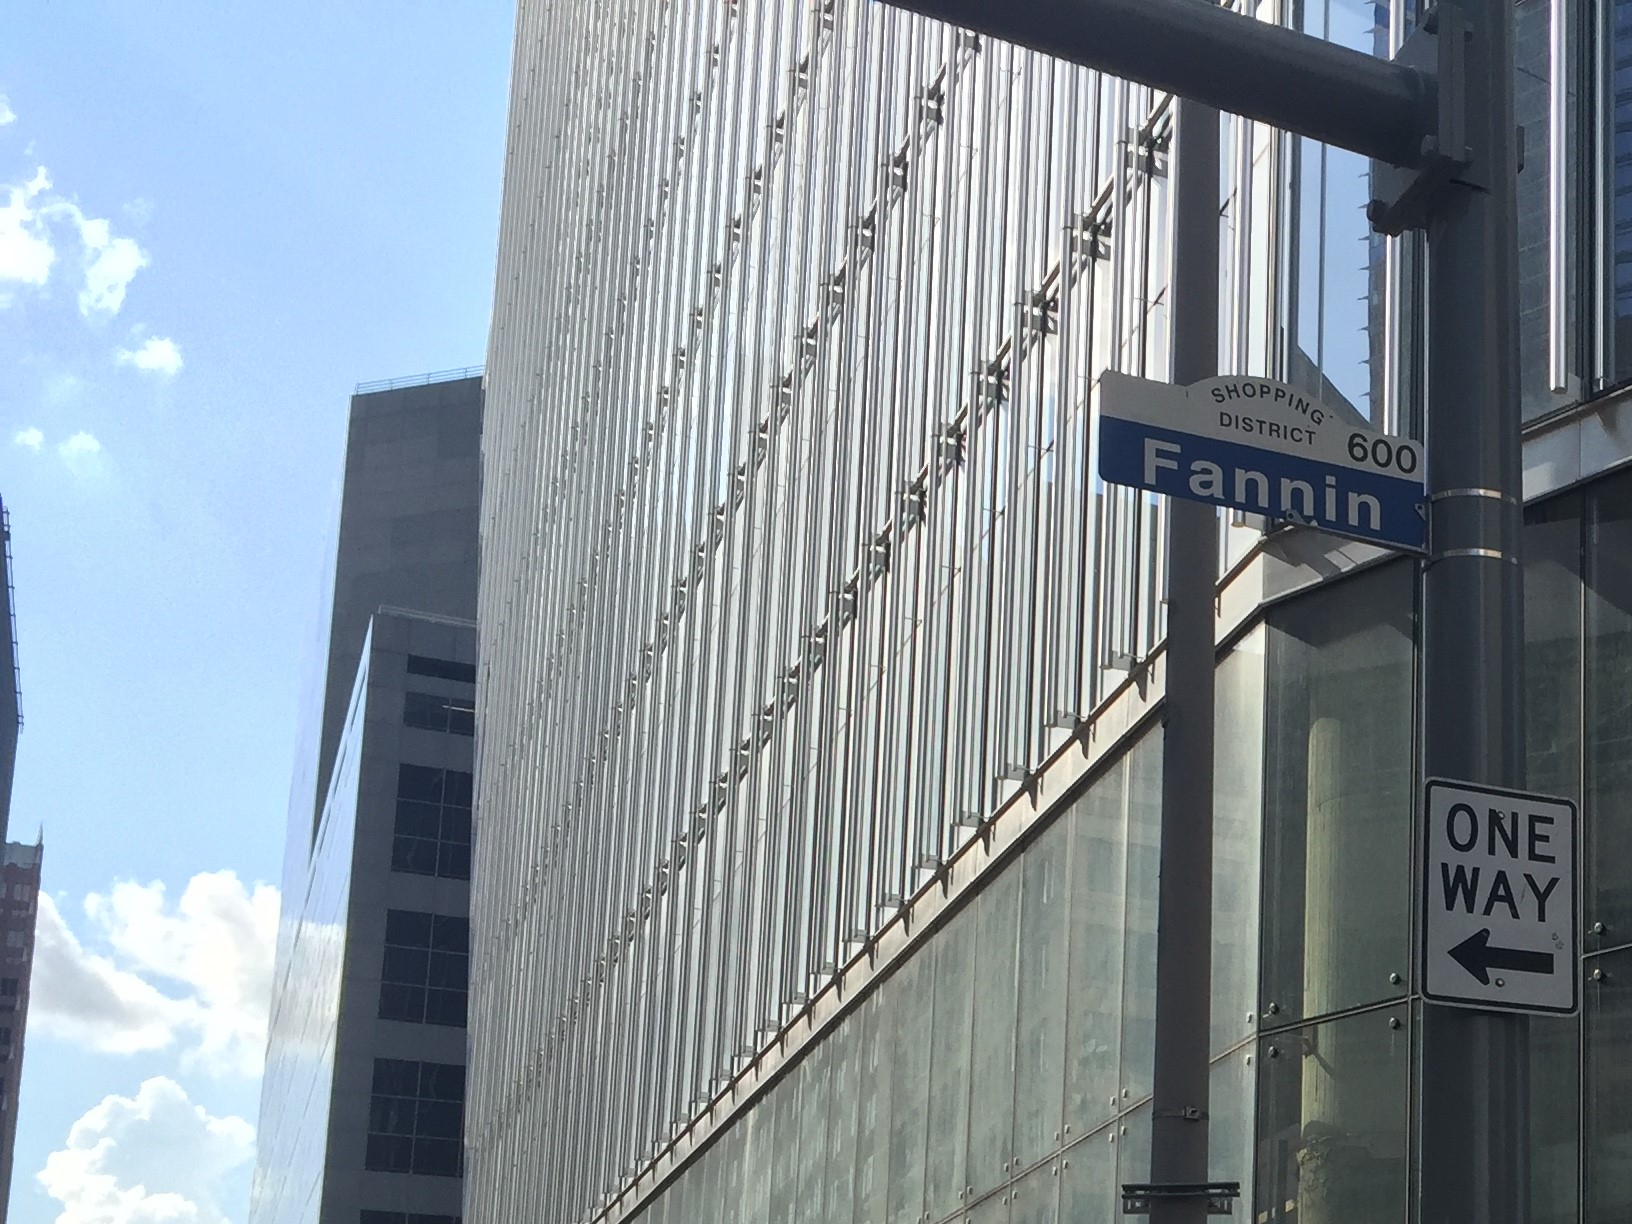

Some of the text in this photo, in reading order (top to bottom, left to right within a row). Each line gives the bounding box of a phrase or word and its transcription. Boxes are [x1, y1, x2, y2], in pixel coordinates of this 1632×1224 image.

[1211, 382, 1325, 425] SHOPPING
[1220, 411, 1317, 446] DISTRICT
[1347, 432, 1417, 474] 600
[1143, 437, 1381, 531] Fannin
[1446, 803, 1556, 865] ONE
[1440, 862, 1561, 923] WAY
